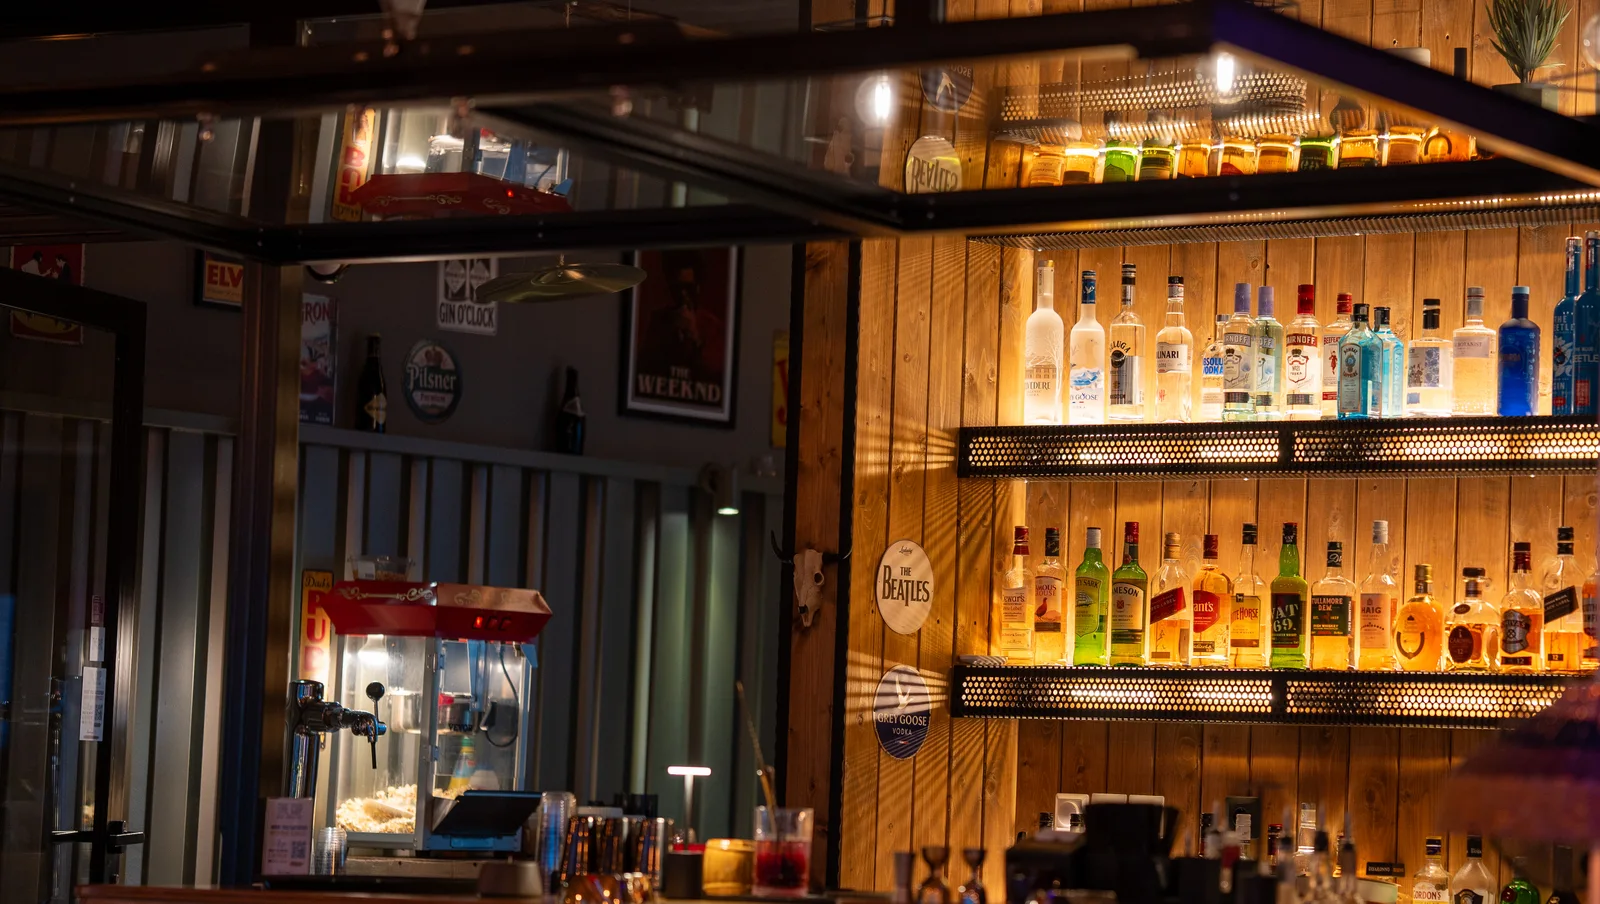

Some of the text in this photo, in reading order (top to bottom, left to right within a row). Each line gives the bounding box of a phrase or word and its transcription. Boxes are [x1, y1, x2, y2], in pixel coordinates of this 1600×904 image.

[439, 302, 495, 329] GIN O'CLOCK
[669, 365, 691, 377] THE
[406, 363, 457, 392] Pilsner
[637, 372, 722, 403] WEEKND
[900, 566, 911, 577] THE
[881, 564, 930, 607] BEATLES
[1003, 594, 1025, 603] ewar's
[1193, 601, 1214, 612] ant's
[1361, 606, 1382, 614] HAIG
[877, 712, 927, 727] GREY GOOSE
[892, 727, 913, 736] VODKA
[1414, 890, 1441, 900] ORDON'S
